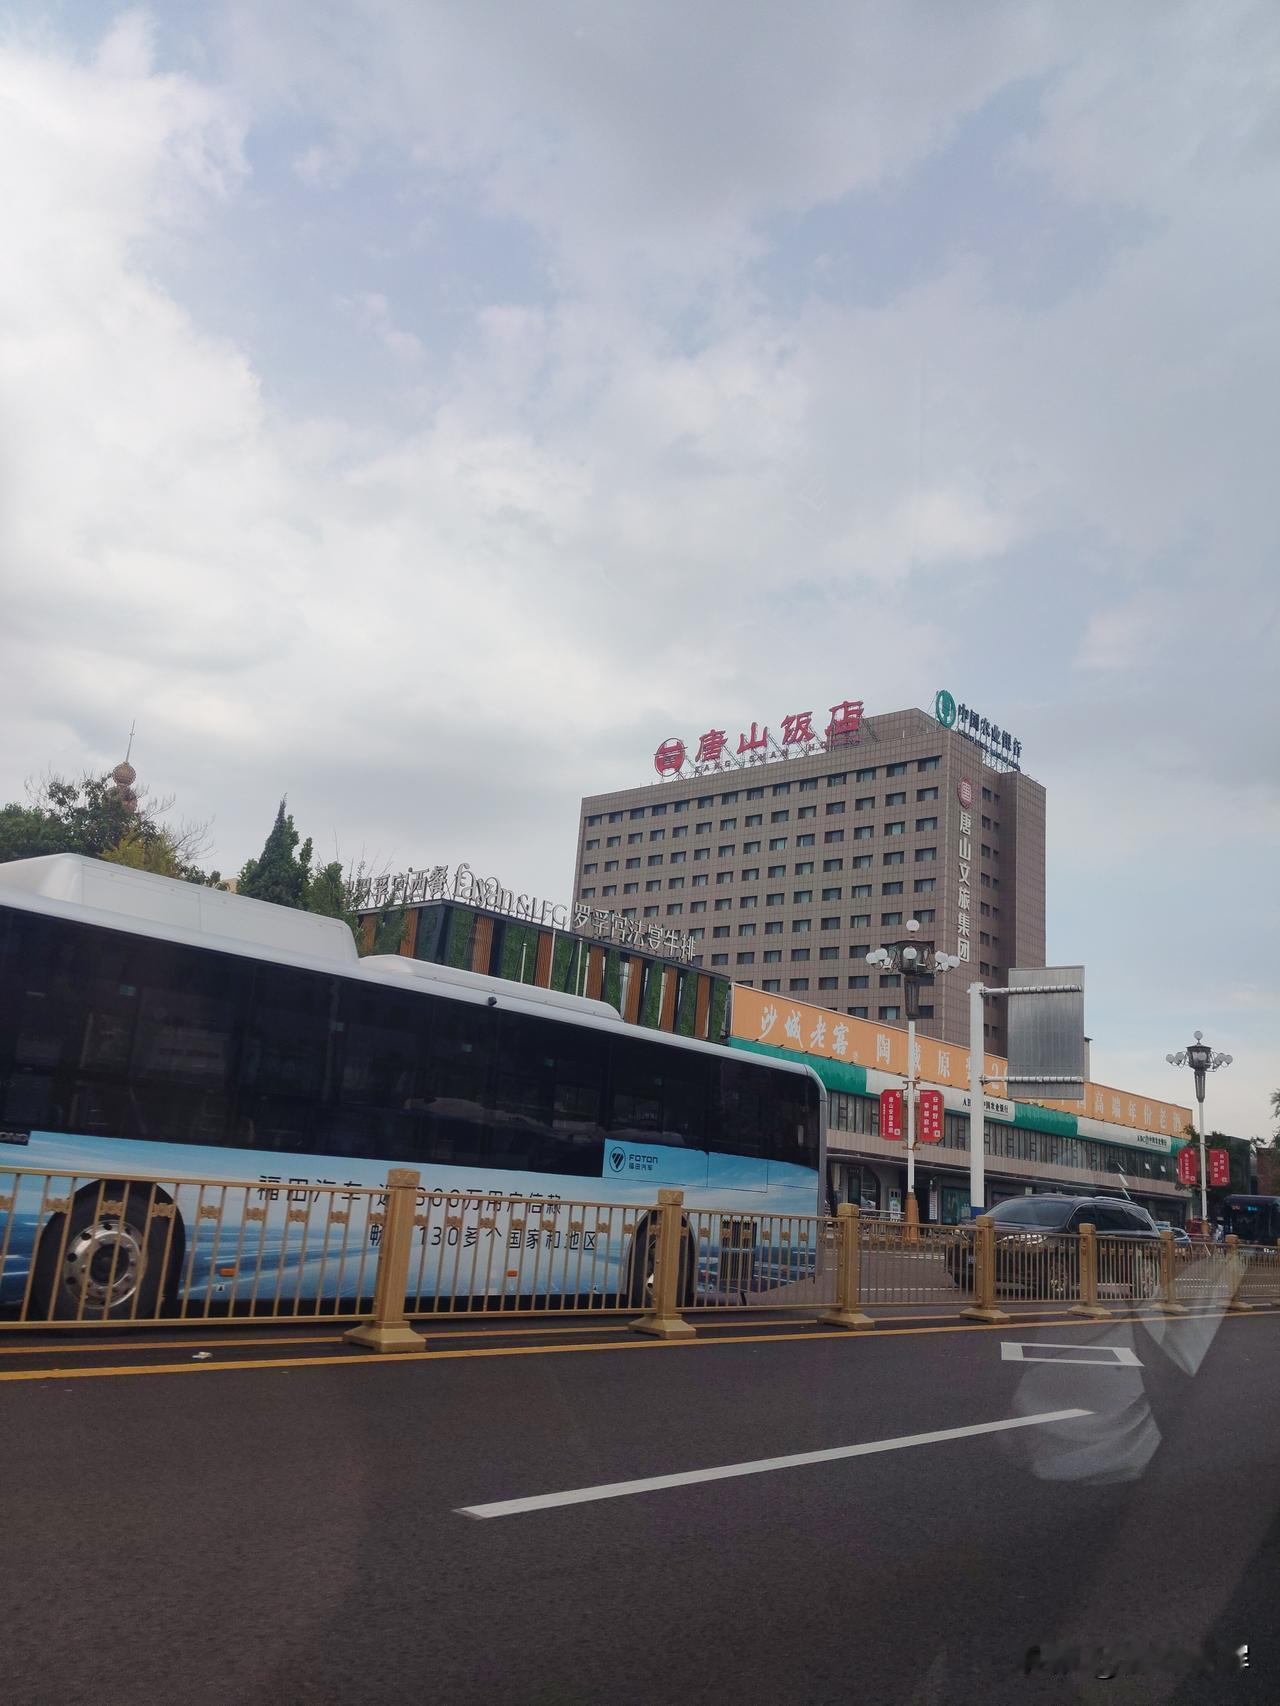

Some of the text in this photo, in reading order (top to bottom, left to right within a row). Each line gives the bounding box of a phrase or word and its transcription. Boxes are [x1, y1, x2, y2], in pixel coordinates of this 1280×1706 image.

[694, 700, 864, 763] 唐山饭店
[957, 703, 1023, 758] 中国农业银行
[958, 810, 971, 963] 唐山文旅集团
[758, 1003, 850, 1056] 沙城老窖
[628, 1154, 659, 1164] FOTON
